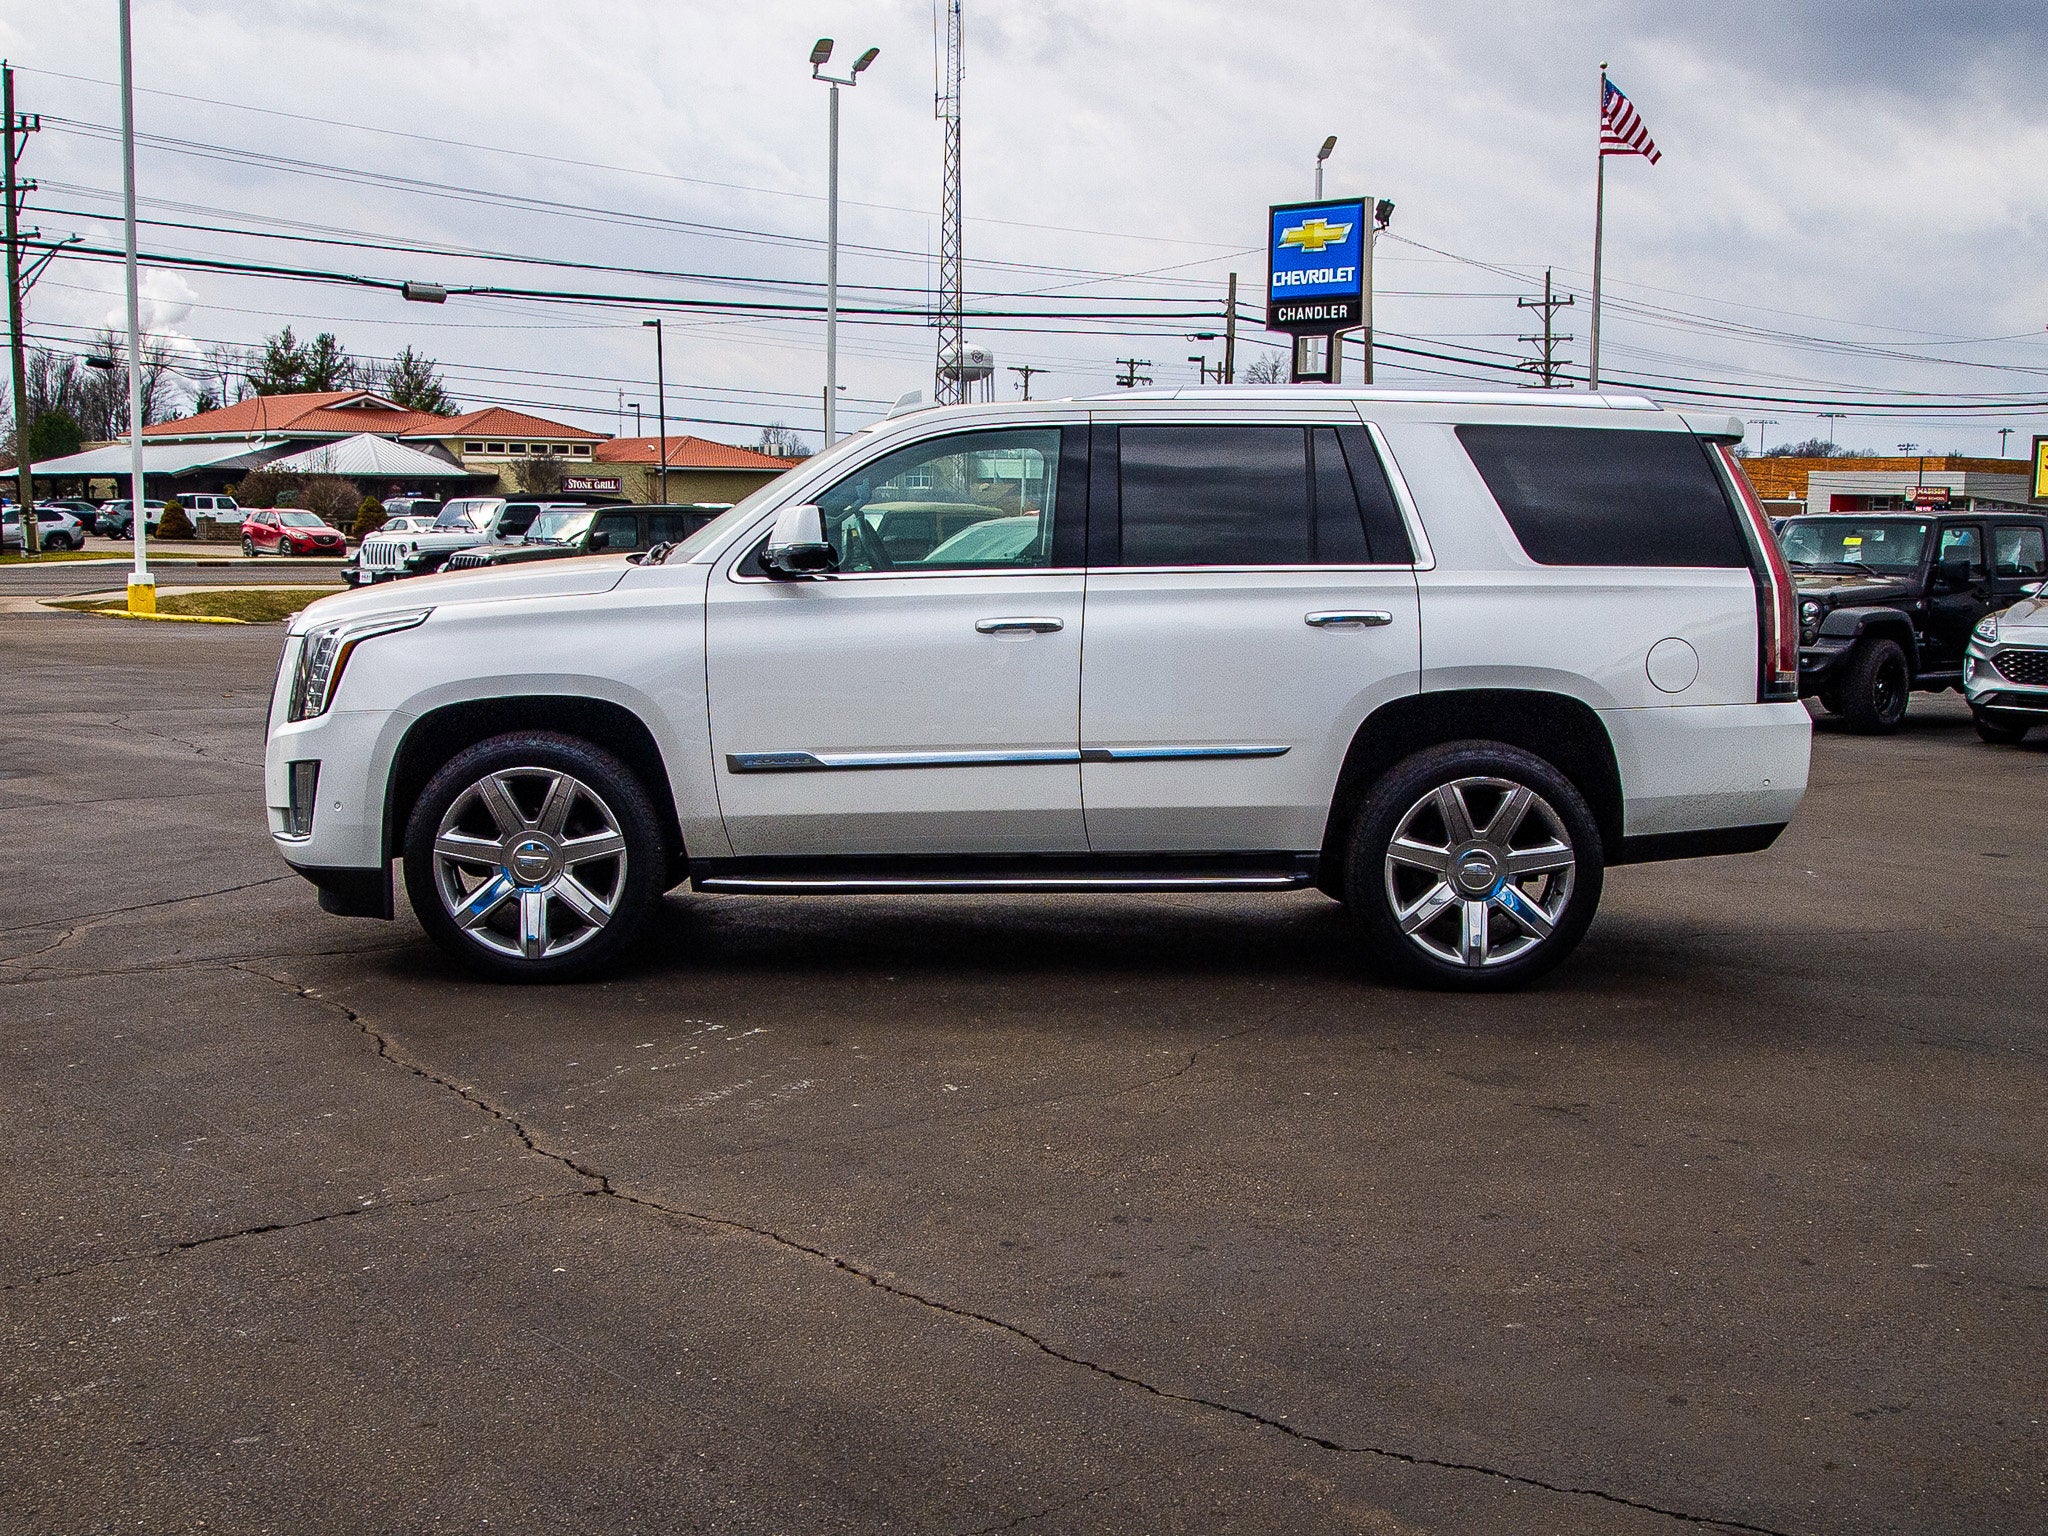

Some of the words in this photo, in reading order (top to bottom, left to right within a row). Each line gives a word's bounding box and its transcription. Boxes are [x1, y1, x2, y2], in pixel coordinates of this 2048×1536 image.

[1273, 267, 1355, 286] CHEVROLET
[1278, 305, 1348, 321] CHANDLER
[568, 479, 592, 489] STONE
[594, 480, 616, 489] GRILL
